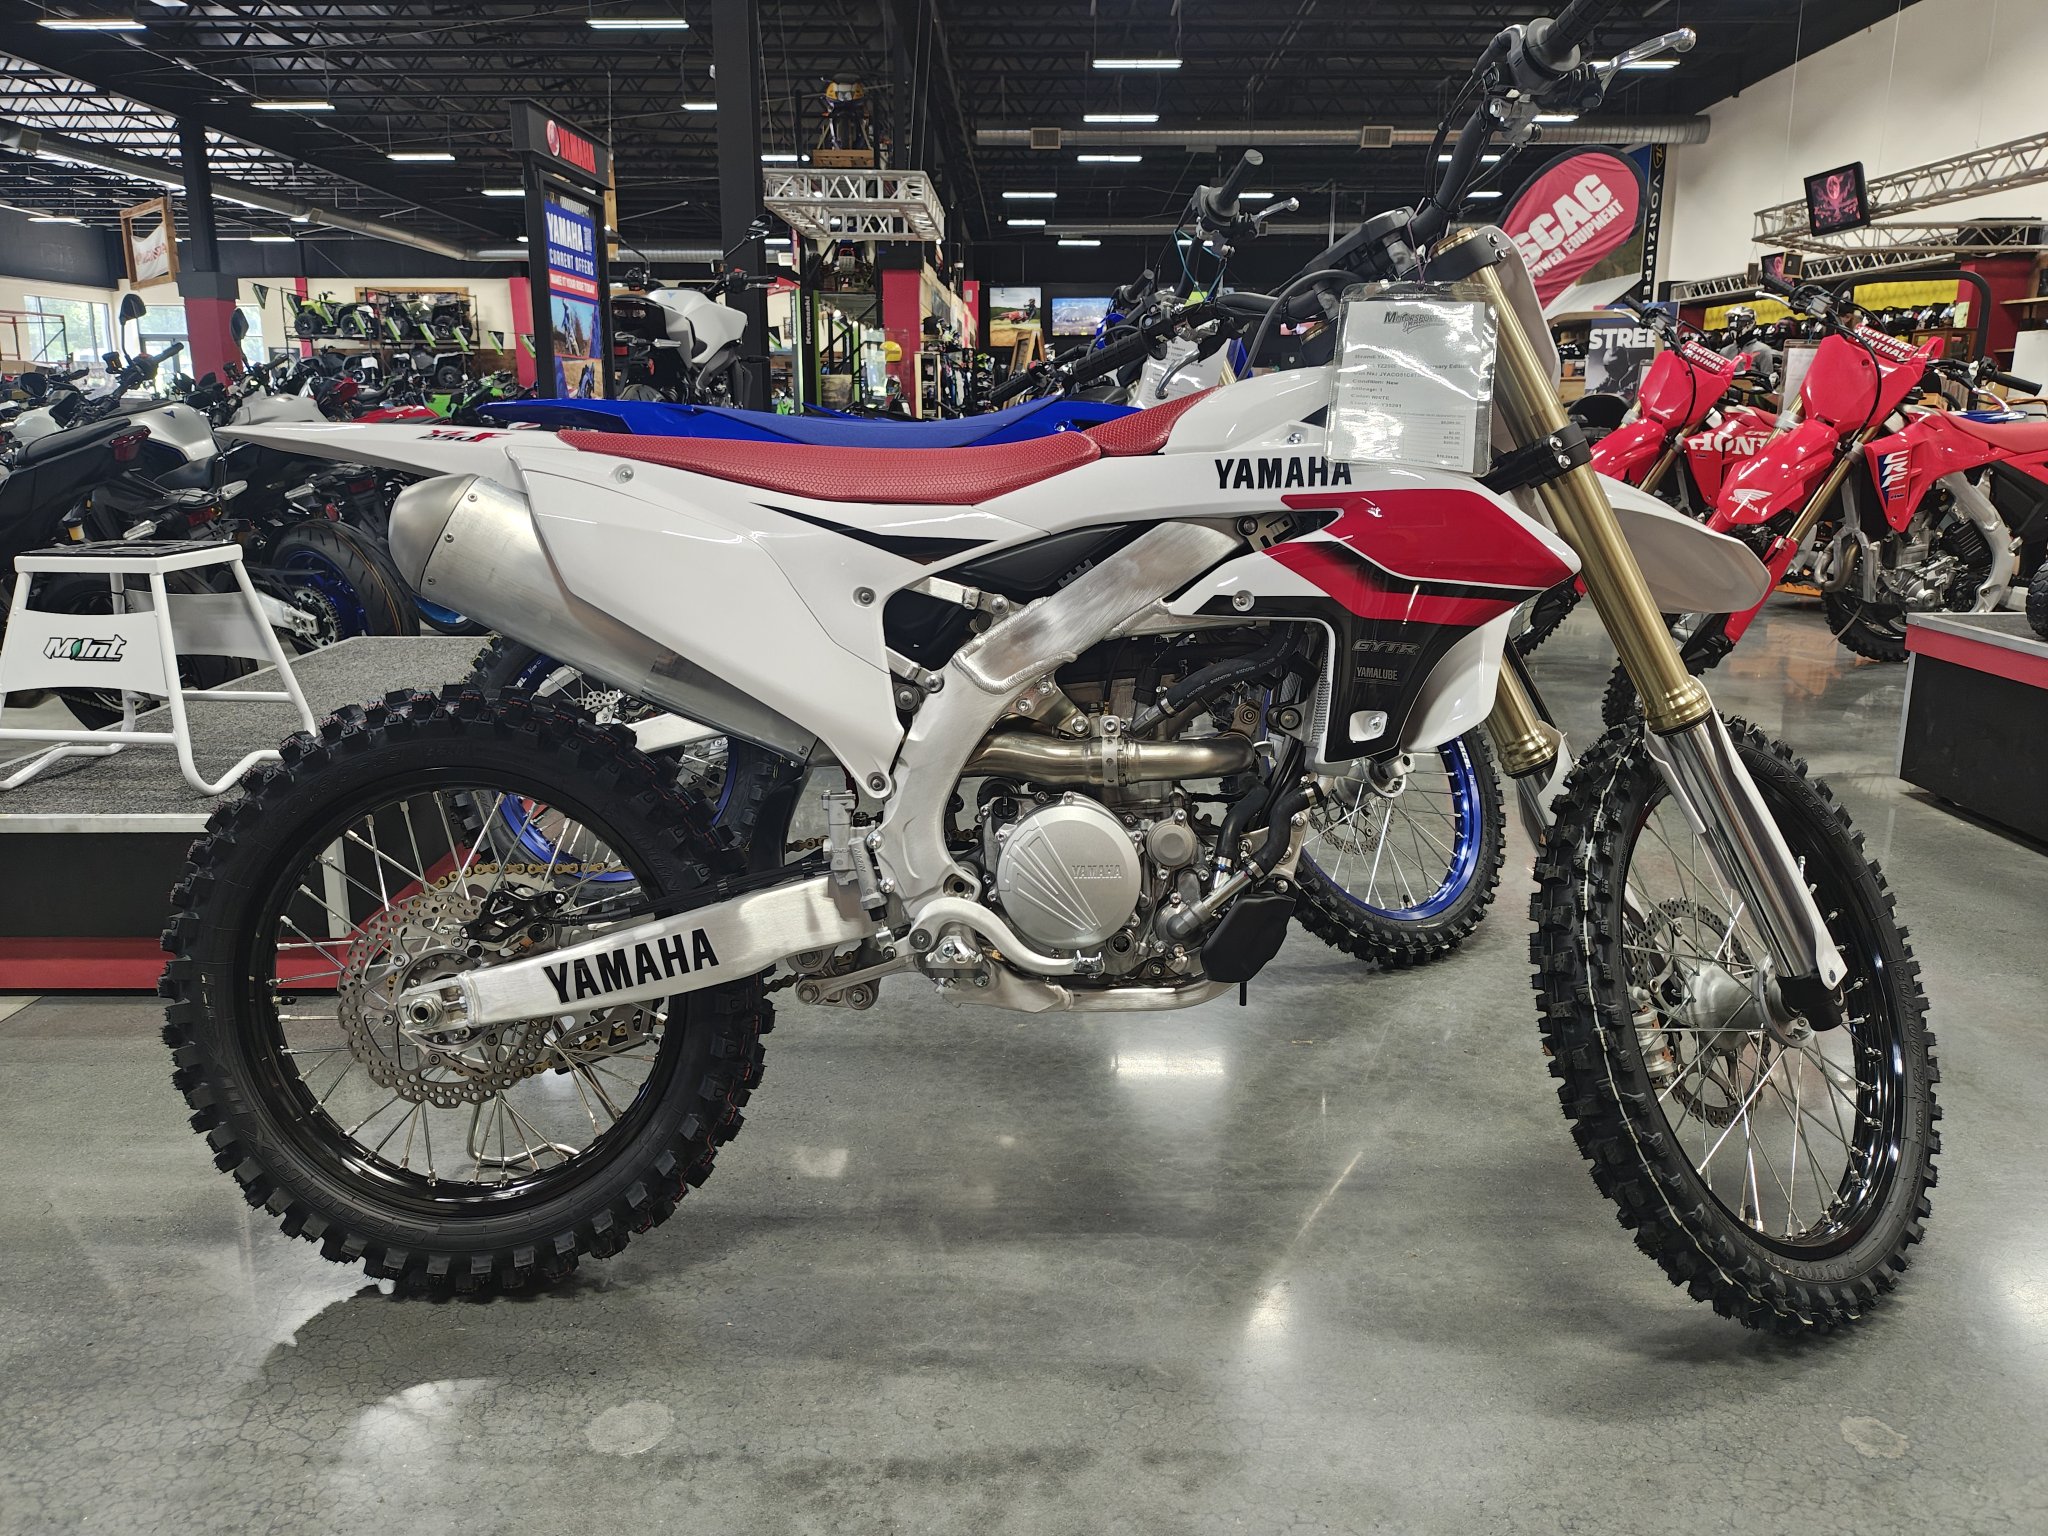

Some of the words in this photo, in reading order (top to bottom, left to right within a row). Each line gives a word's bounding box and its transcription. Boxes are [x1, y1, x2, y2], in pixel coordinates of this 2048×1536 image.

[557, 125, 597, 175] YAMAHA
[546, 211, 584, 254] YAMAHA
[1511, 173, 1613, 269] SCAG
[1528, 248, 1567, 283] POWER
[1562, 199, 1625, 255] EQUIPMENT
[1642, 174, 1662, 304] VONZIPPE
[549, 248, 574, 270] CURRENT
[574, 256, 594, 277] OFFERS
[1588, 327, 1677, 350] STREE
[1688, 432, 1768, 456] HON
[1214, 456, 1353, 490] YAMAHA
[1728, 496, 1760, 514] HONDA
[1352, 638, 1421, 656] GYTR
[1356, 666, 1398, 681] YAMALUBE
[1071, 864, 1123, 880] YAMAHA
[541, 927, 720, 1005] YAMAHA
